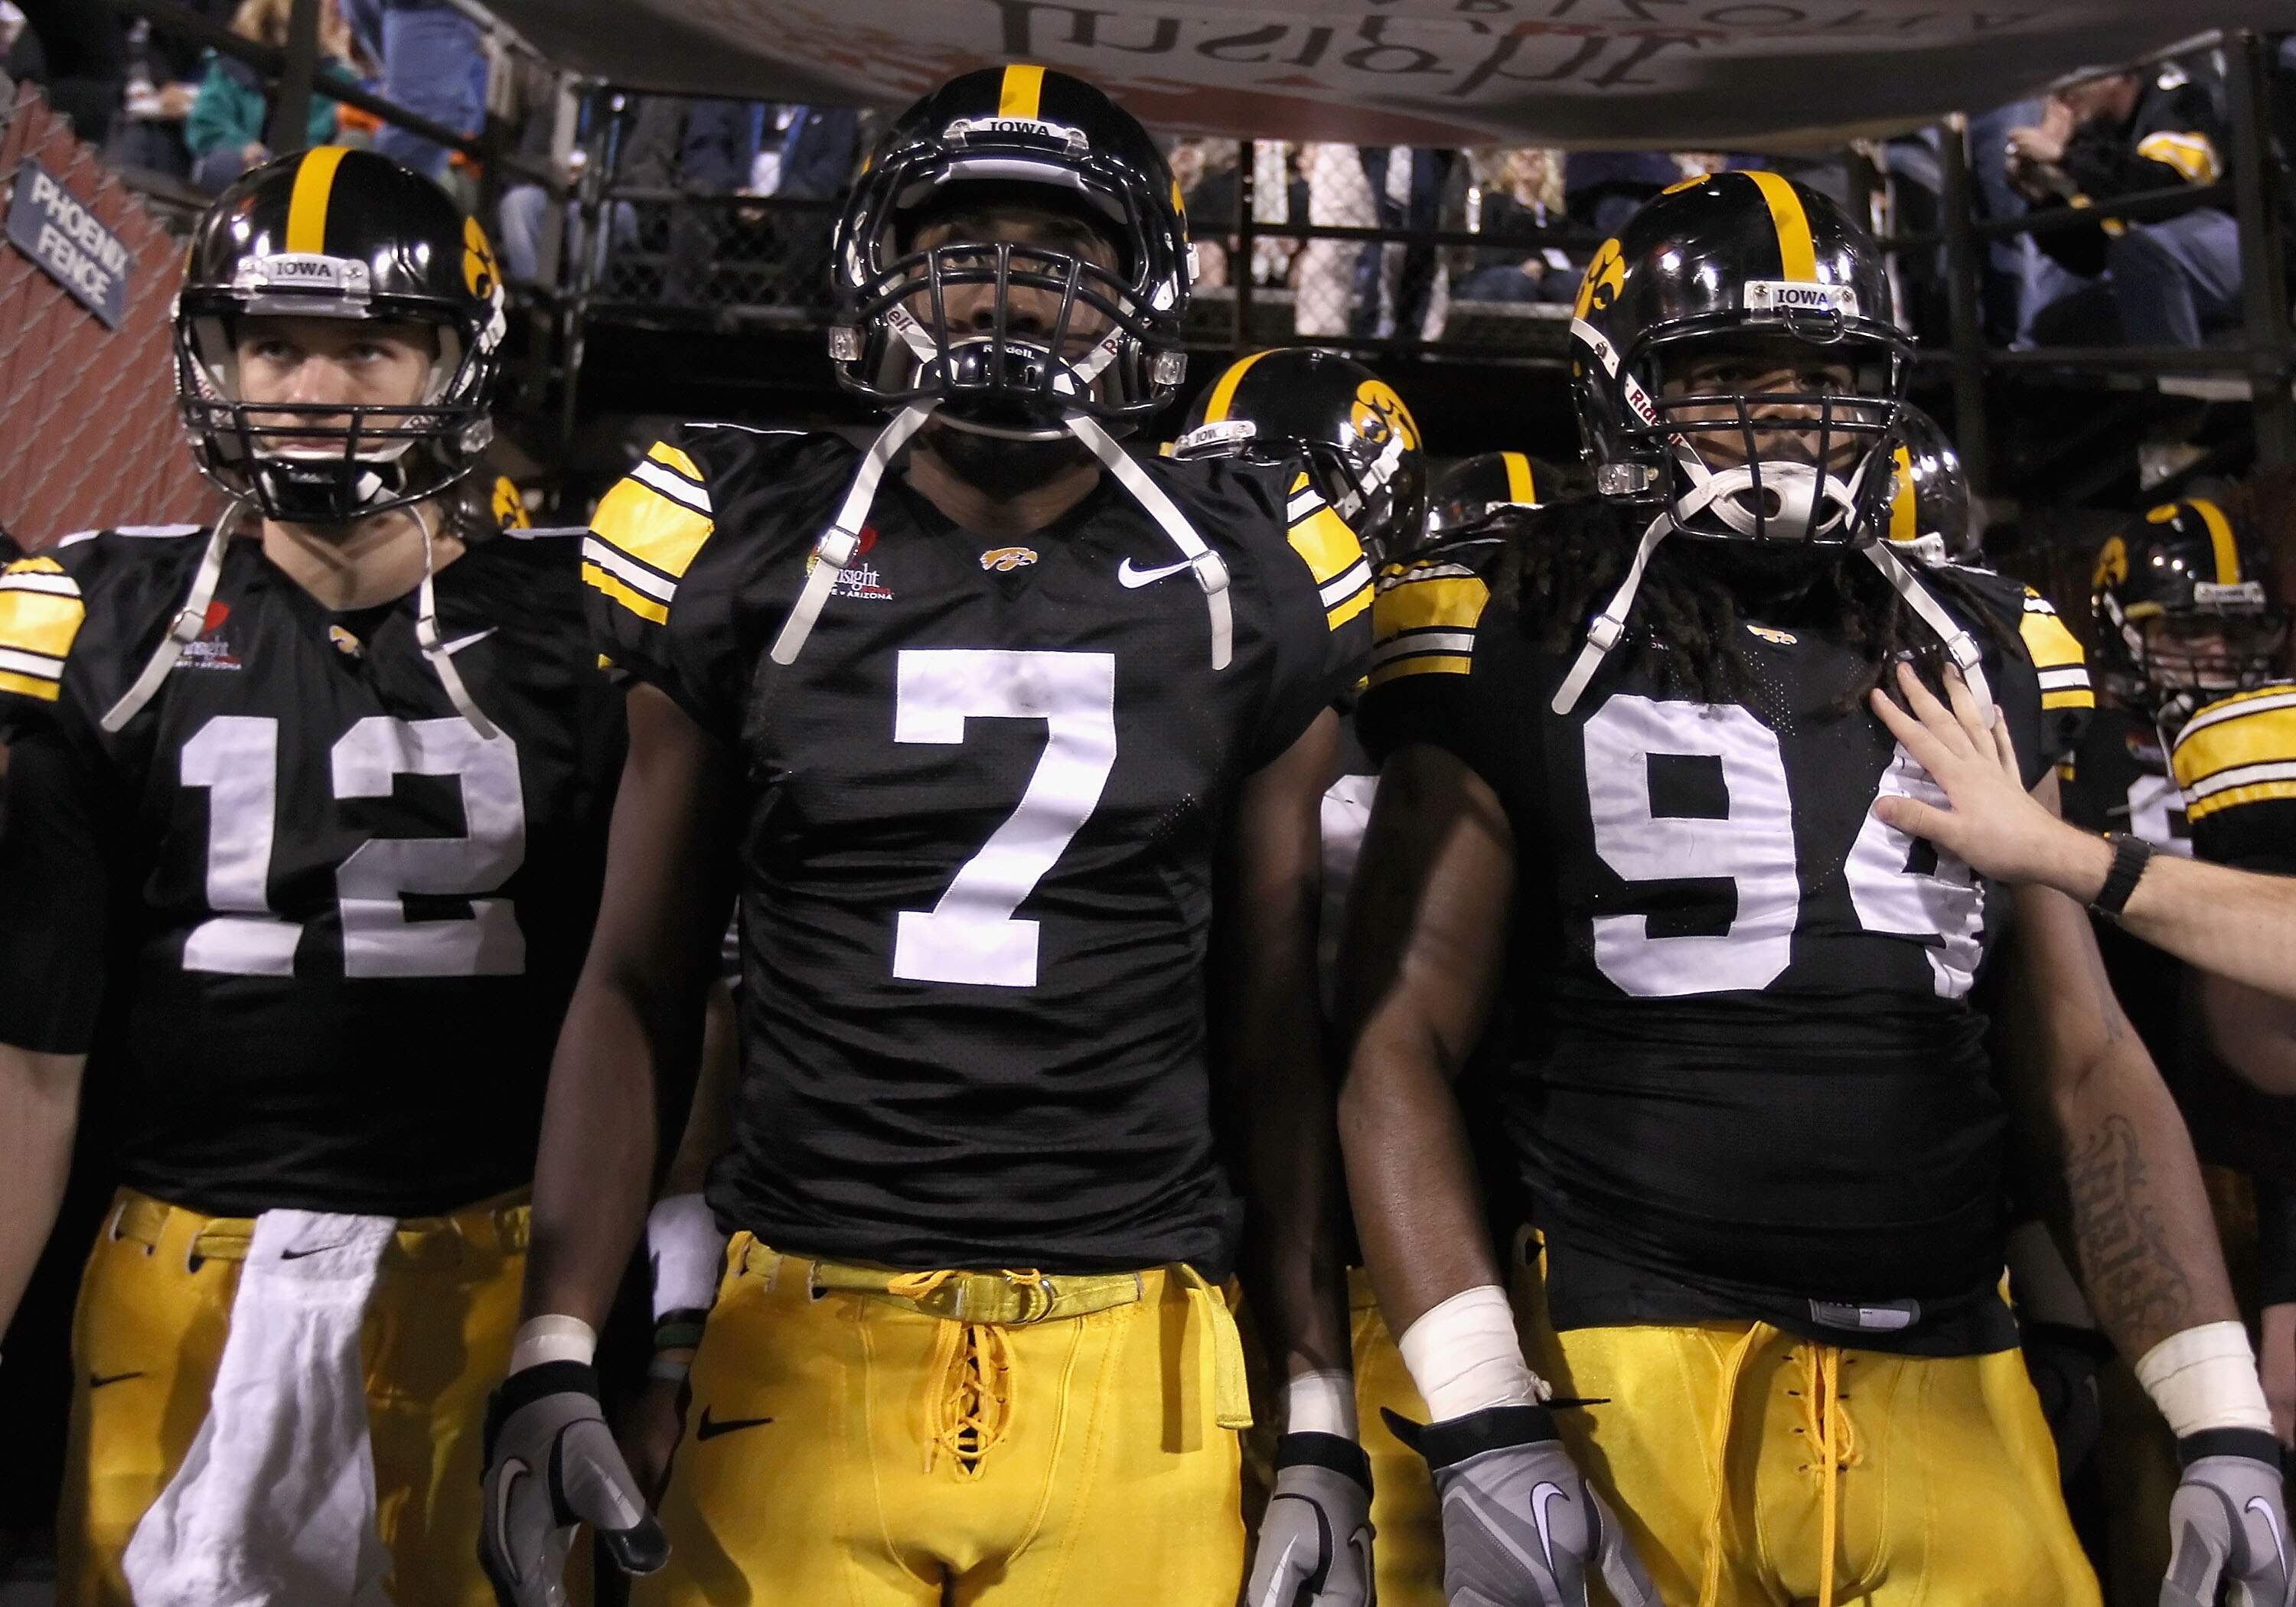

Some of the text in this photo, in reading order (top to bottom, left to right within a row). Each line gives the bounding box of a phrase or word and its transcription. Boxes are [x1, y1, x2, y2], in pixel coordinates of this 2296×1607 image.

[990, 122, 1050, 136] IOWA
[31, 171, 128, 281] PHOENIX
[38, 223, 112, 305] FENCE
[277, 262, 331, 277] IOWA
[1777, 289, 1828, 305] IOWA
[846, 588, 893, 601] ARIZONA
[181, 715, 527, 978] 12
[892, 649, 1117, 987] 7
[1583, 693, 1985, 999] 94
